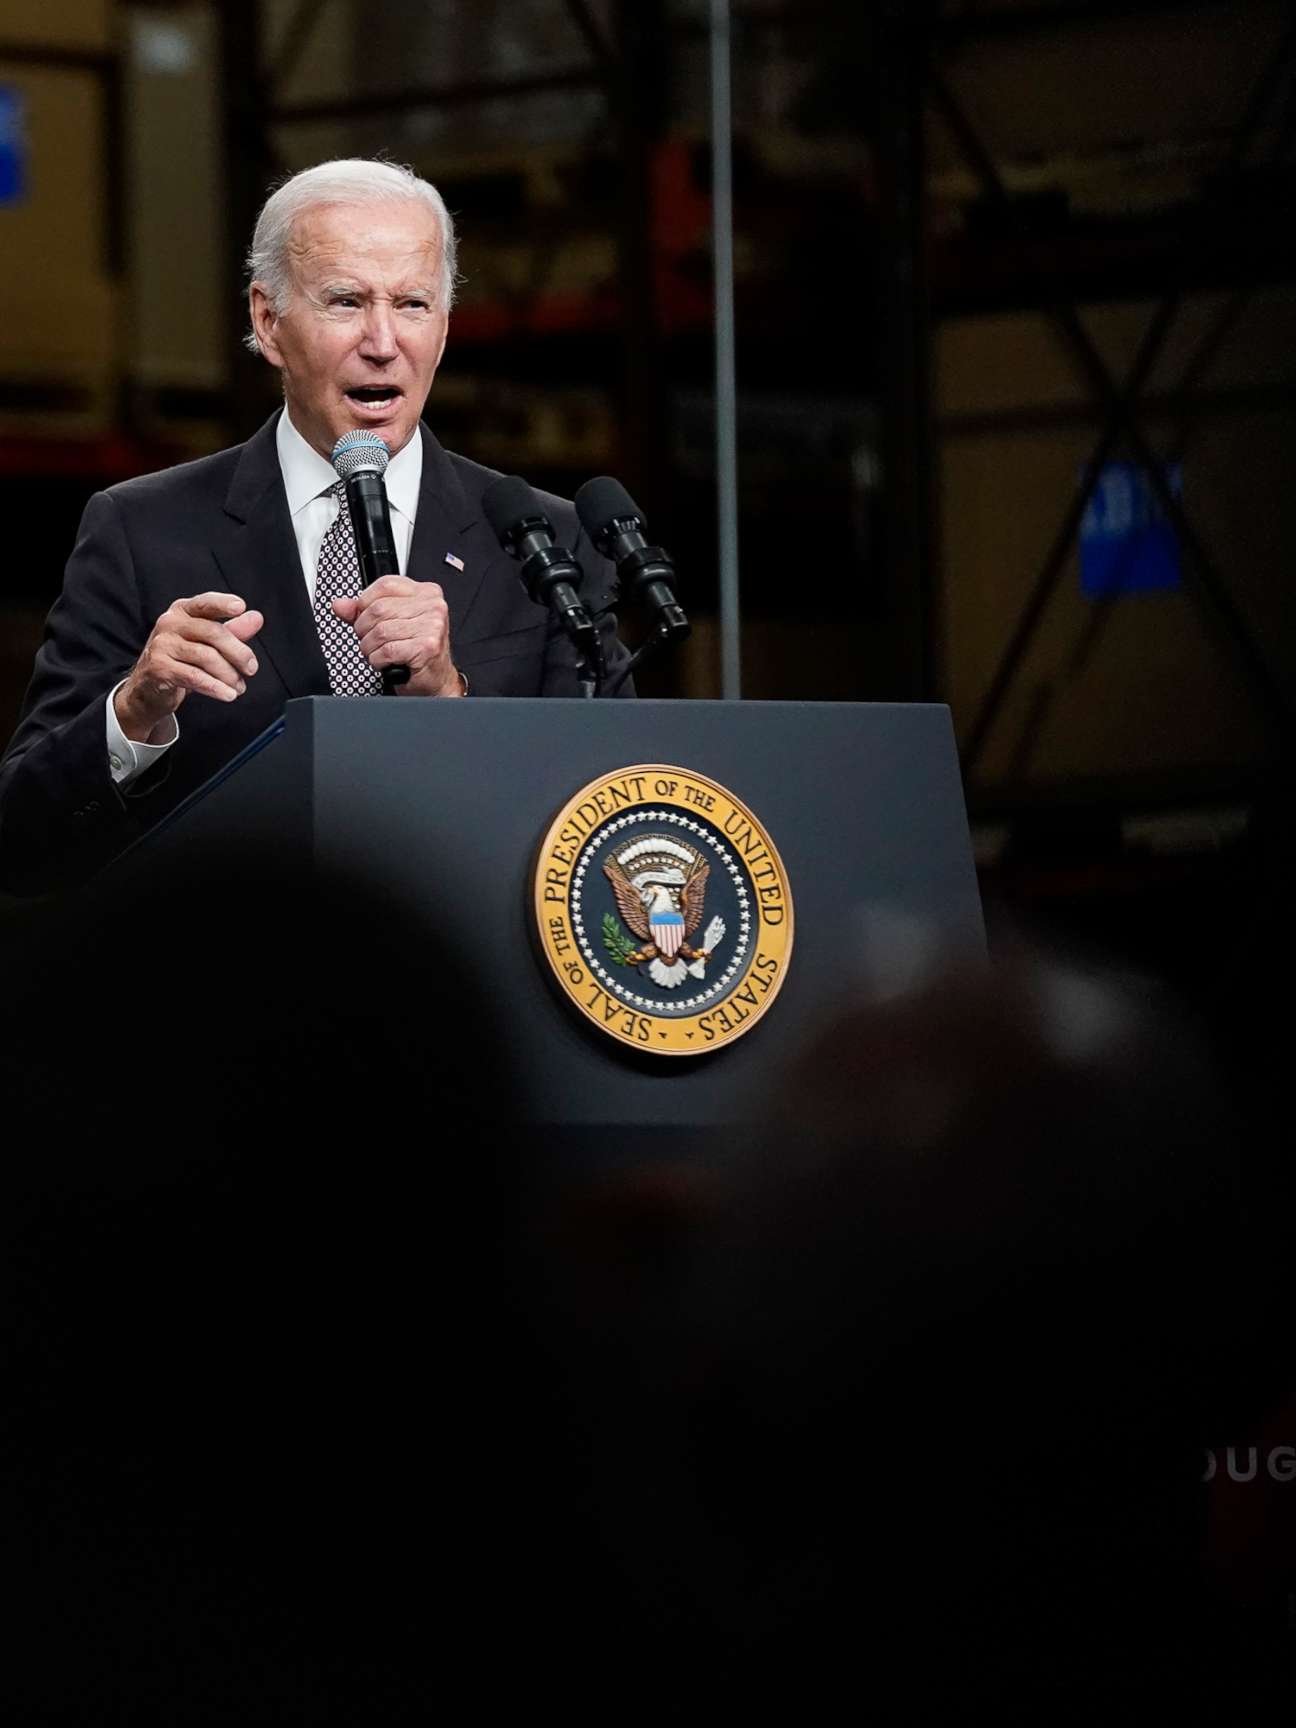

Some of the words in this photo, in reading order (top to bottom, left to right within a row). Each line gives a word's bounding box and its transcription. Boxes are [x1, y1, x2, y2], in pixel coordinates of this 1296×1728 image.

[654, 779, 678, 797] OF
[683, 785, 715, 814] THE
[544, 777, 646, 904] PRESIDENT
[723, 809, 784, 927] UNITED
[549, 916, 570, 956] THE
[563, 960, 584, 985] OF
[698, 953, 778, 1041] STATES
[586, 983, 652, 1042] SEAL
